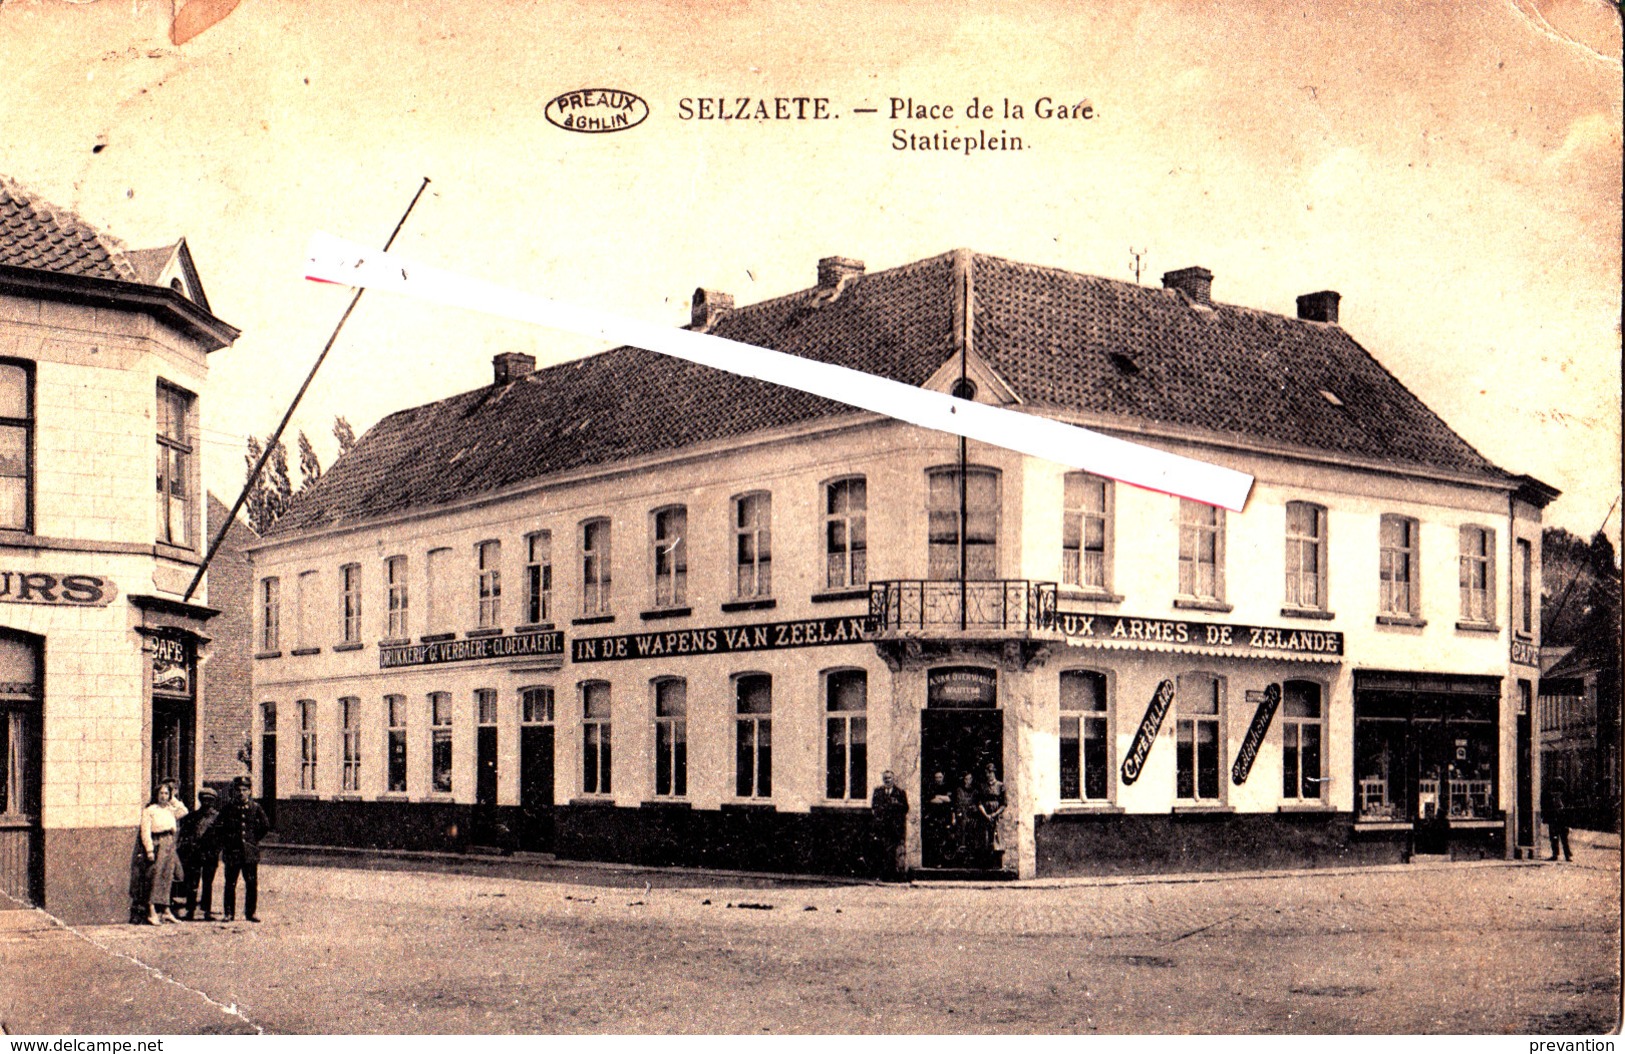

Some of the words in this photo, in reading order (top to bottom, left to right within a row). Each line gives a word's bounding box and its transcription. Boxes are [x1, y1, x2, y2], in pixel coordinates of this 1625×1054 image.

[578, 640, 597, 660] IN
[602, 637, 628, 658] DE
[635, 630, 718, 656] WAPENS
[723, 626, 768, 649] VAN
[775, 618, 872, 646] ZEELAN
[1111, 620, 1189, 643] ARMES
[1206, 625, 1233, 646] DE
[1249, 629, 1340, 652] ZELANDE
